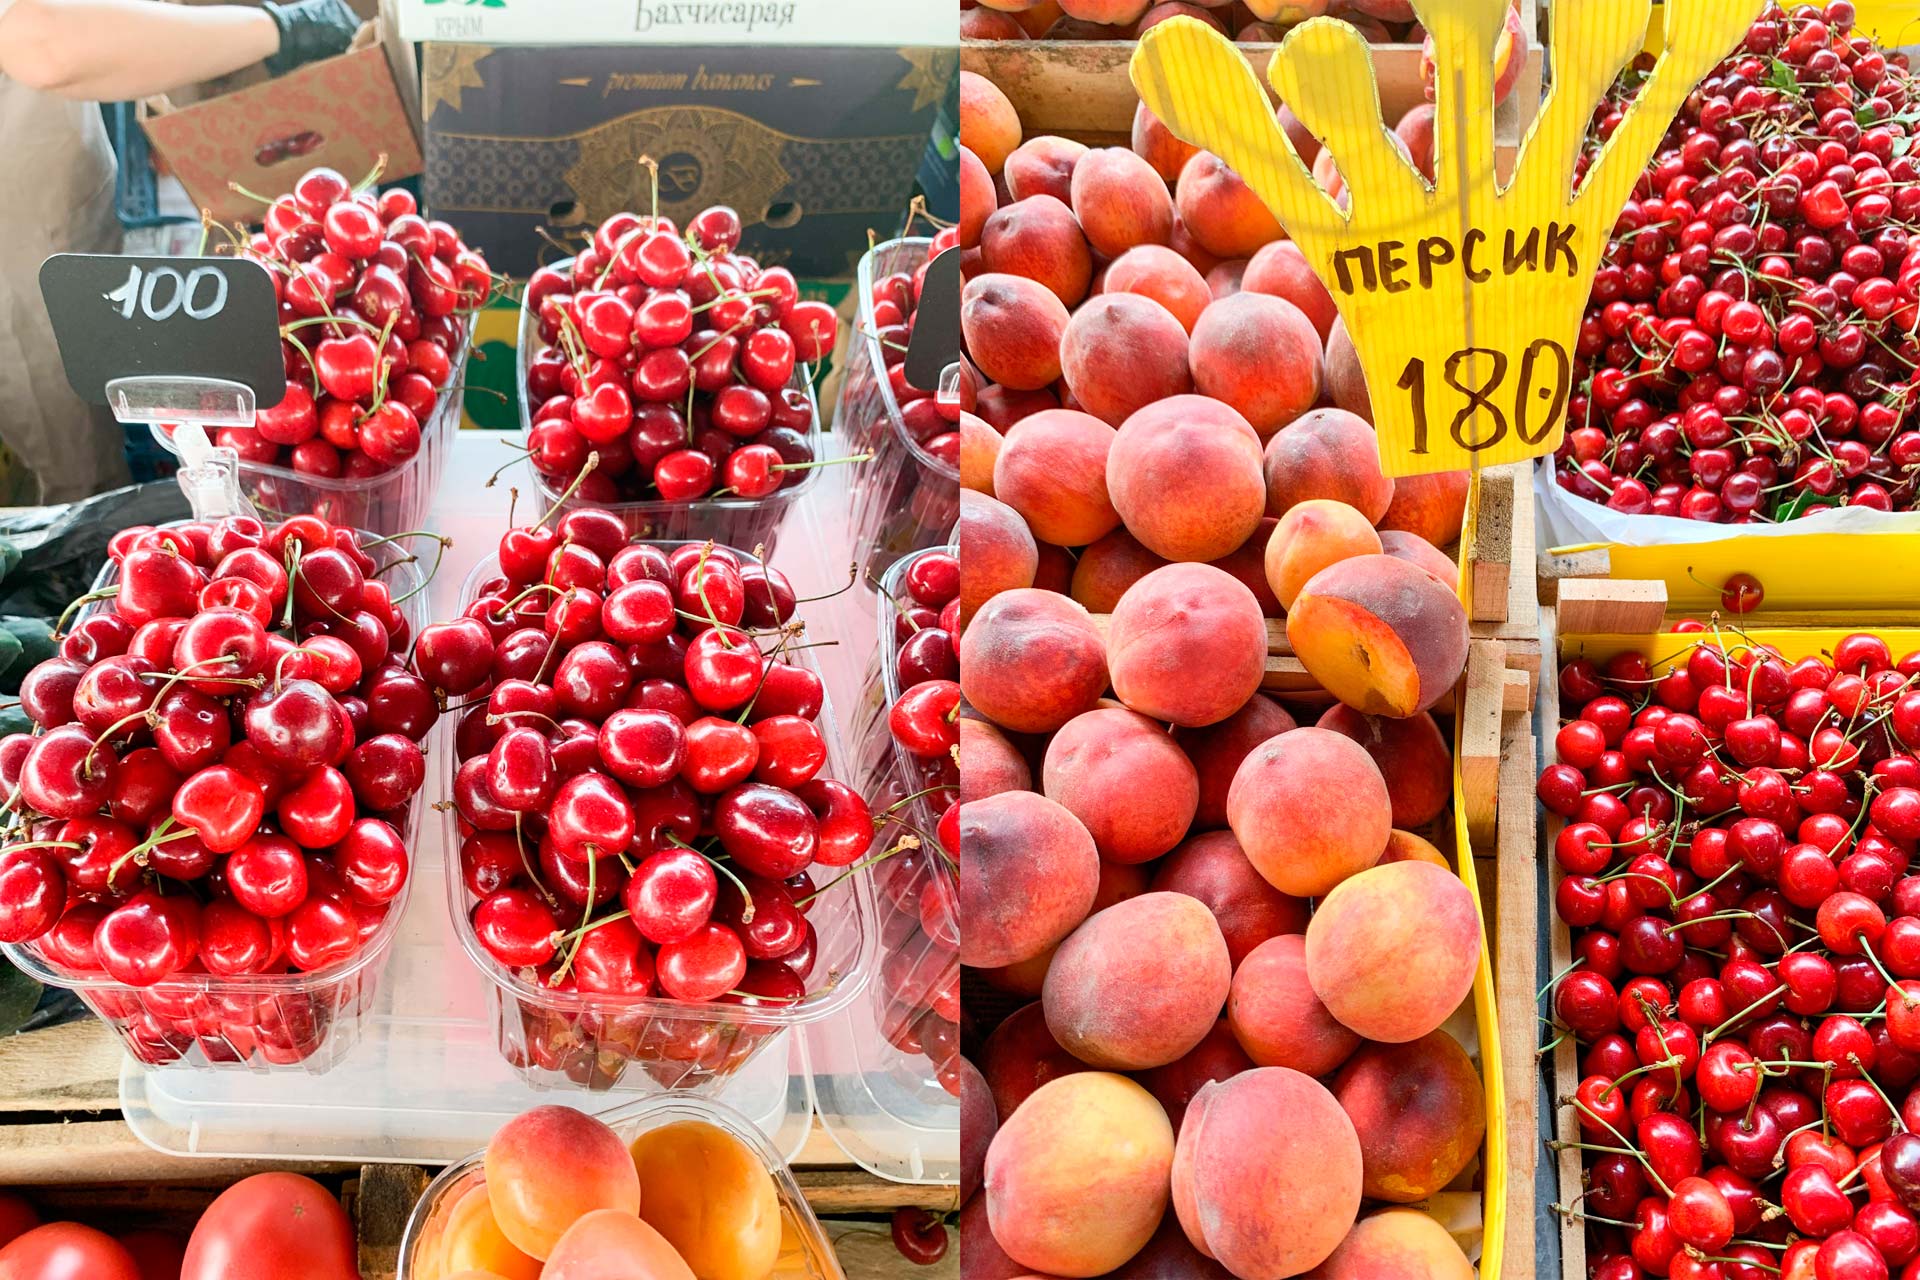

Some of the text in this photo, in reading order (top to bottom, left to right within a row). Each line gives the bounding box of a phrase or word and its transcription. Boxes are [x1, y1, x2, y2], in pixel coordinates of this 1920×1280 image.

[434, 15, 484, 38] КРЫМ
[635, 0, 797, 32] Бахчисарая
[603, 70, 688, 98] premium
[1333, 221, 1578, 295] ПЕРСИК
[103, 264, 229, 321] 100
[1396, 338, 1570, 454] 180
